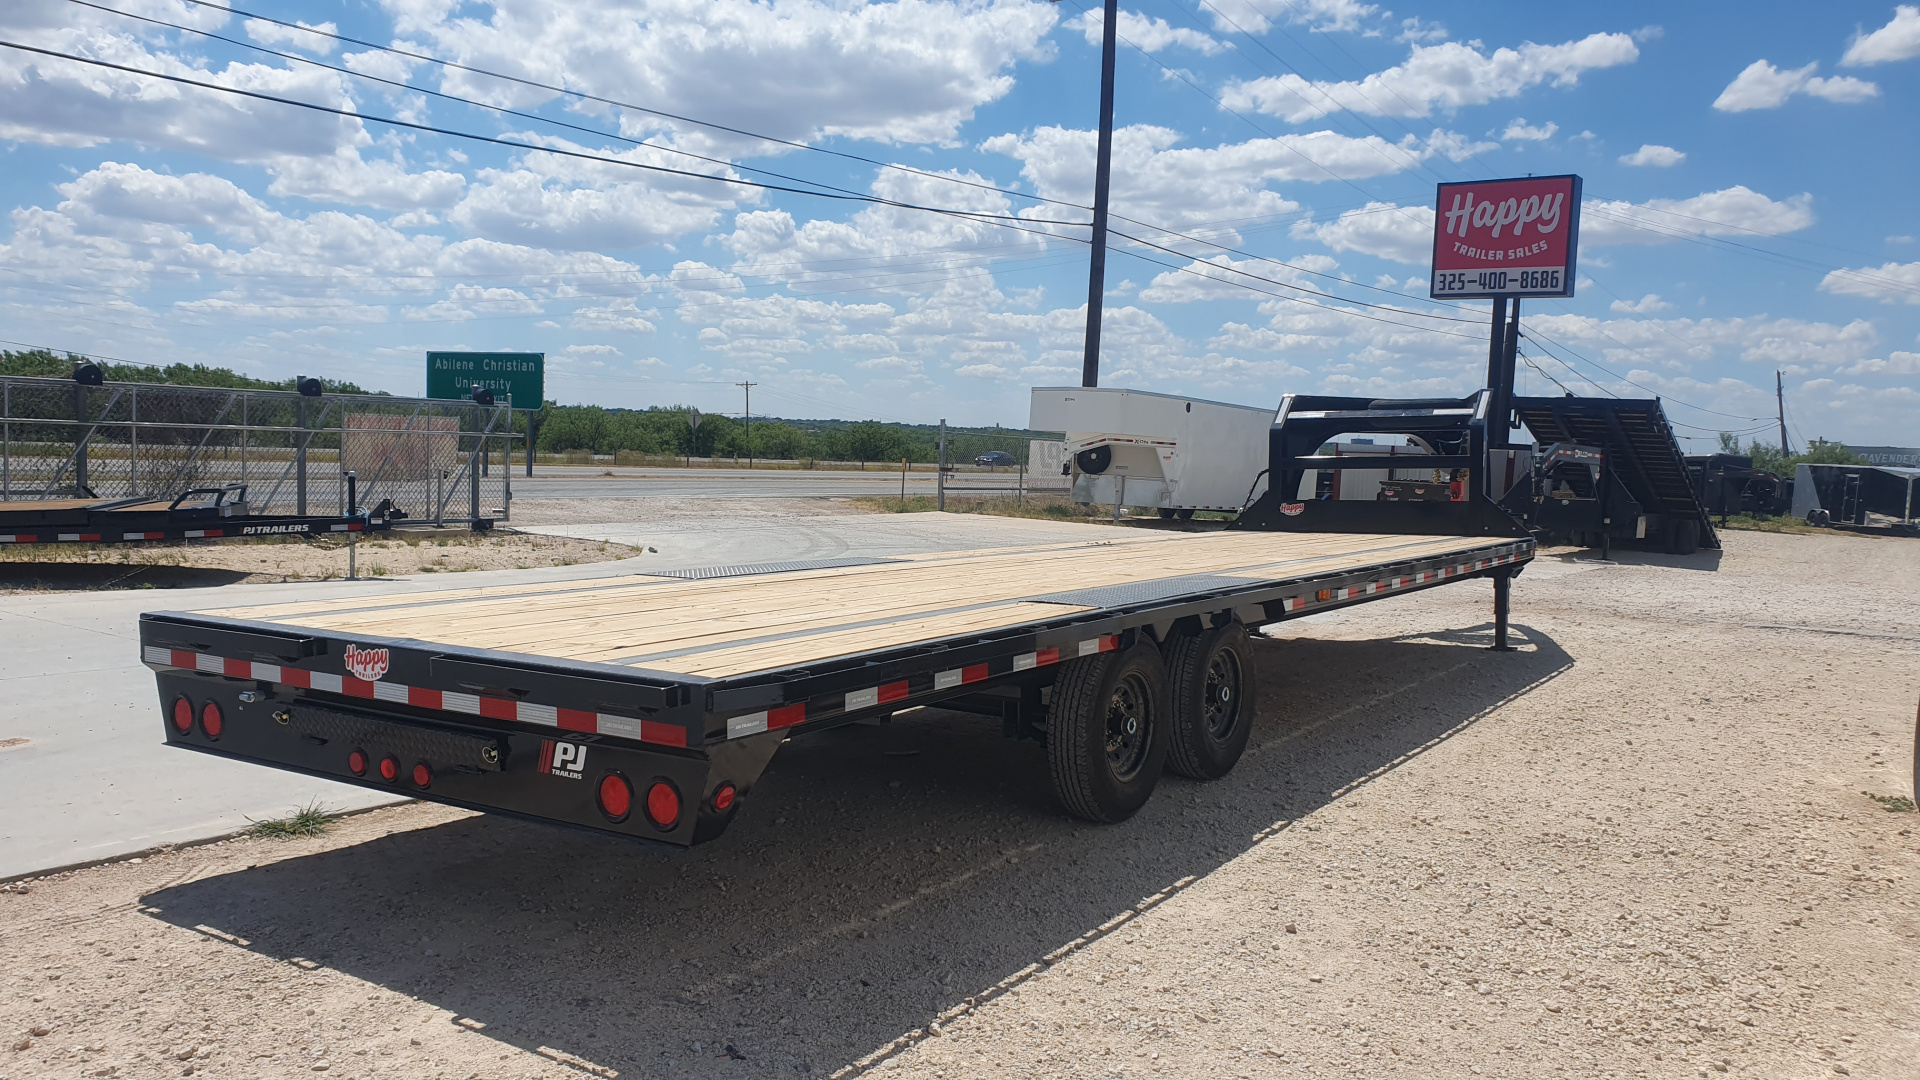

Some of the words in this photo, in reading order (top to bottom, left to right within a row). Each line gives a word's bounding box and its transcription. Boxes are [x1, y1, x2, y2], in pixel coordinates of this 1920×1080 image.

[1445, 192, 1564, 238] Happy
[1453, 241, 1504, 261] TRAILER
[1508, 240, 1548, 260] SALES
[1438, 270, 1559, 290] 325-400-8686
[435, 358, 474, 370] Abilene
[483, 359, 535, 372] Christian
[455, 376, 512, 392] University
[1858, 452, 1920, 465] CAVENDER
[243, 526, 256, 535] PJ
[256, 524, 310, 534] TRAILERS
[345, 645, 388, 672] Happy
[552, 741, 587, 771] PJ
[551, 768, 583, 780] TRAILERS
